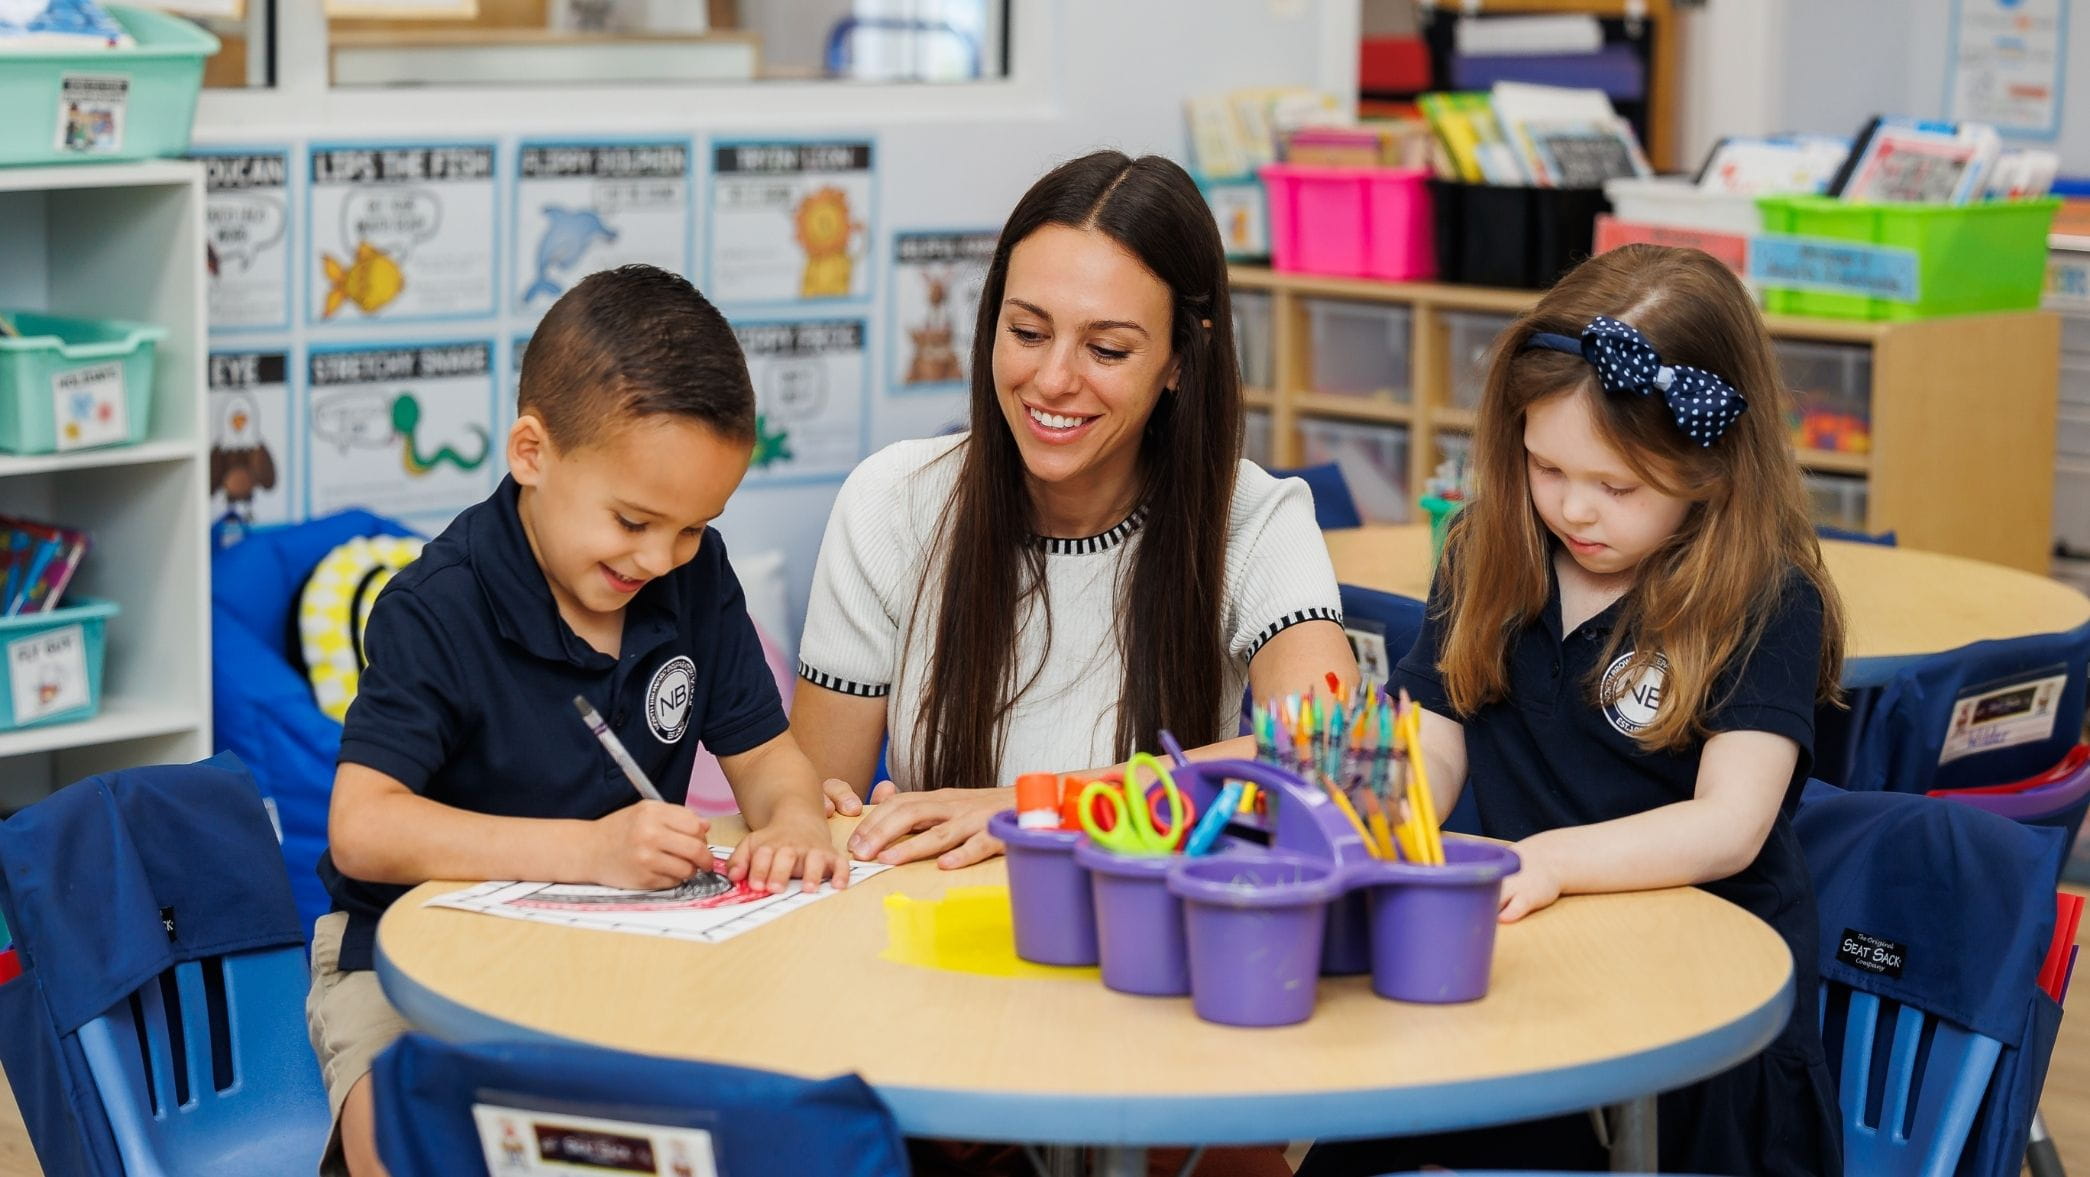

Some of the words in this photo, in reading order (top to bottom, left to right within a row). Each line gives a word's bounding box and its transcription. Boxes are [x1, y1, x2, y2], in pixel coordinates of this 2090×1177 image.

[207, 157, 283, 186] OUCAN
[209, 355, 259, 385] EYE
[661, 684, 686, 717] NB
[1842, 938, 1871, 958] SEAT
[1872, 948, 1900, 968] SACK
[1857, 933, 1867, 942] The
[1867, 937, 1895, 950] Original
[1855, 957, 1886, 972] Company
